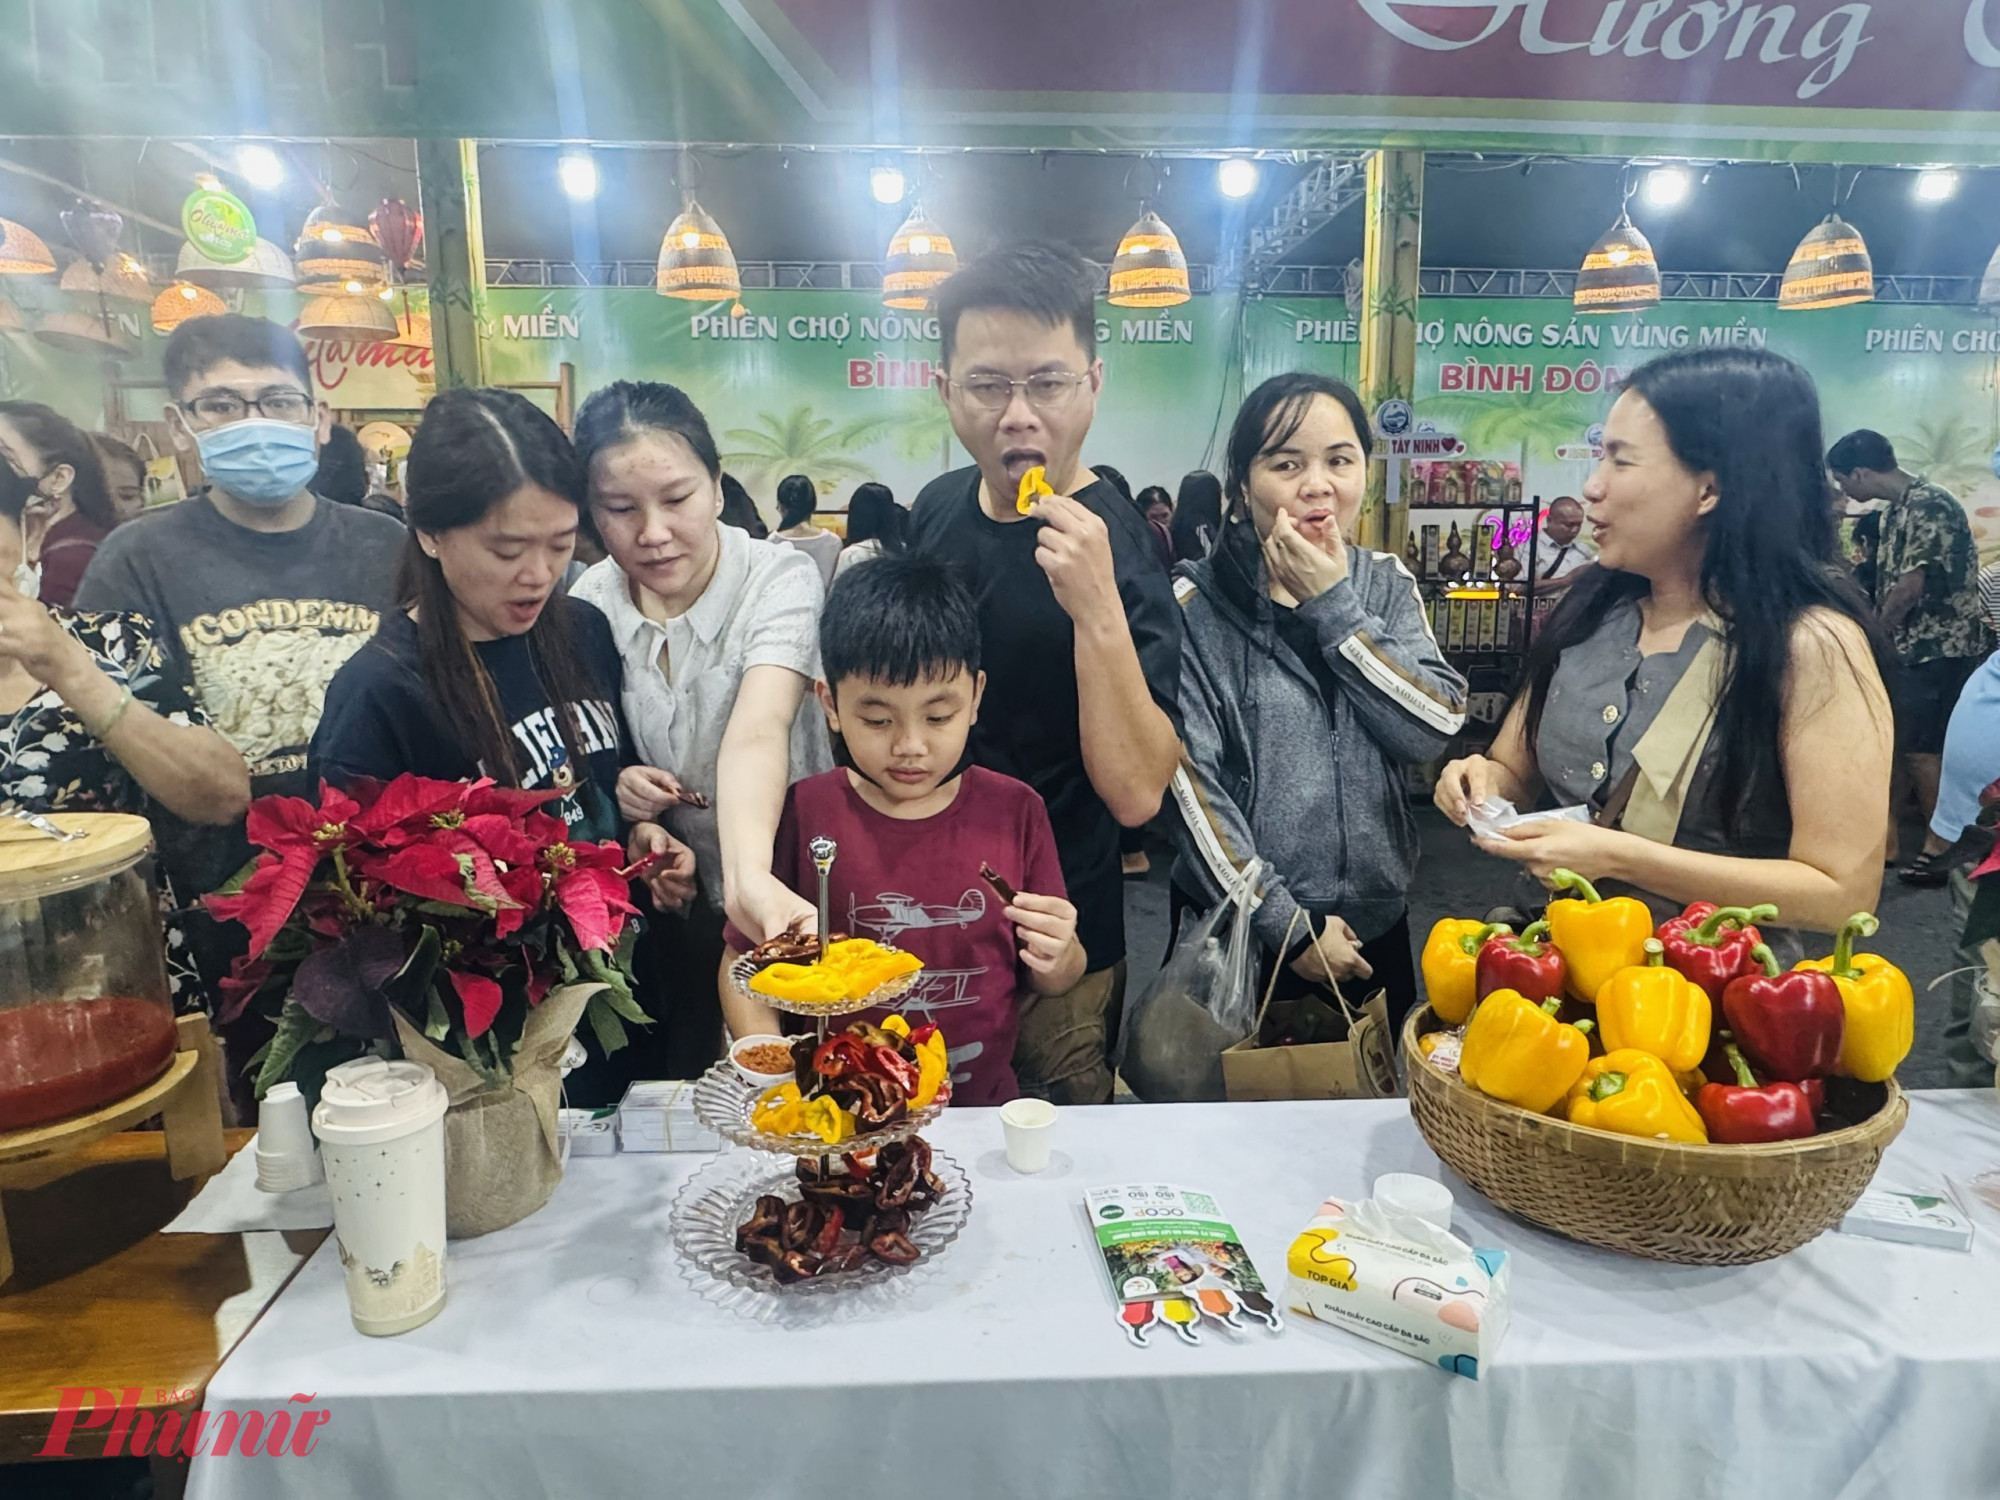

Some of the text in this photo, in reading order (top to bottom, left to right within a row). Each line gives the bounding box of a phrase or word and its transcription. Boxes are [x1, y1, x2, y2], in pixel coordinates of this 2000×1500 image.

[502, 304, 580, 338] MIỀN
[690, 309, 778, 339] PHIÊN
[787, 312, 850, 347] CHỢ
[860, 309, 941, 340] NÔNG
[1121, 309, 1193, 342] MIỀN
[1295, 314, 1361, 342] PHIÊ
[1453, 317, 1533, 347] NÔNG
[1541, 316, 1600, 347] SẢN
[1610, 318, 1689, 348] VÙNG
[1699, 315, 1768, 349] MIỀN
[1865, 322, 1944, 352] PHIÊN
[1440, 356, 1533, 393] BÌNH
[1413, 439, 1440, 454] NINH
[1134, 1207, 1184, 1217] OCOP
[1307, 1269, 1349, 1292] TOP GIA
[1365, 1318, 1382, 1328] CAO
[1383, 1323, 1399, 1333] CẤP
